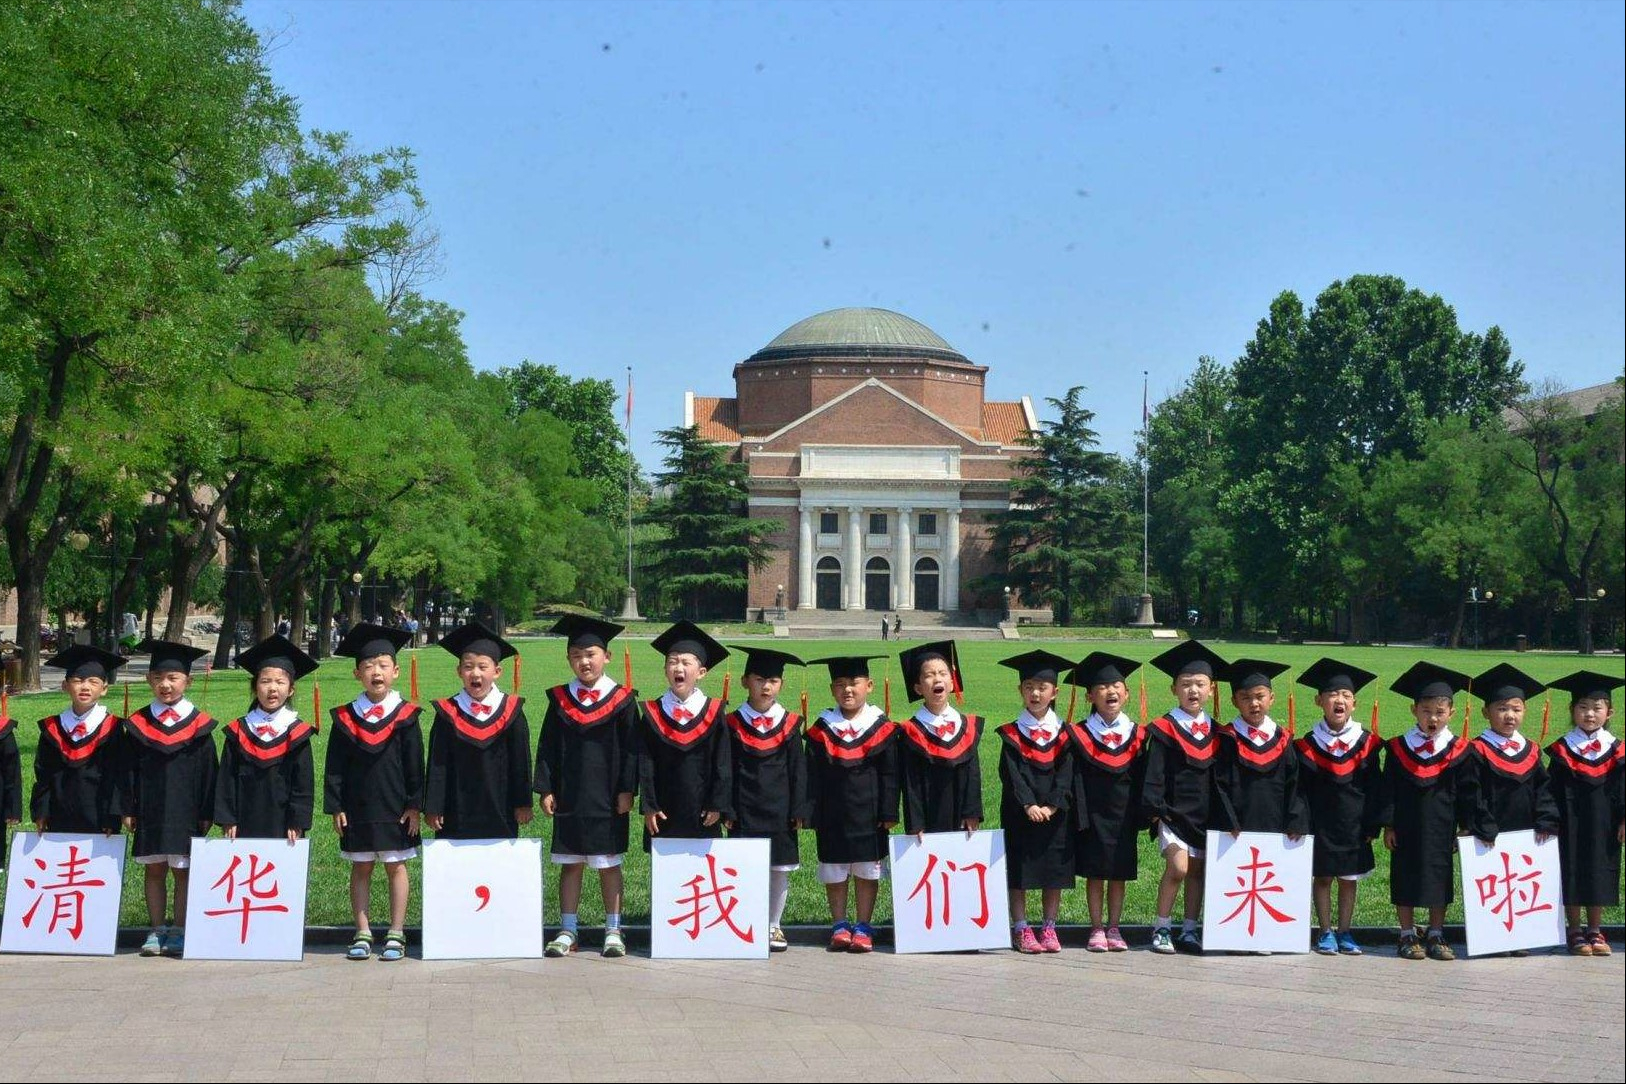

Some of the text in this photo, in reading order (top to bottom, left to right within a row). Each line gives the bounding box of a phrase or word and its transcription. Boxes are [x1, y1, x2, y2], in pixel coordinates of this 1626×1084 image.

[21, 845, 106, 941] 清
[203, 854, 289, 944] 华
[667, 853, 754, 945] 我
[907, 853, 989, 930] 们
[1218, 846, 1296, 937] 来
[1475, 851, 1553, 932] 啦
